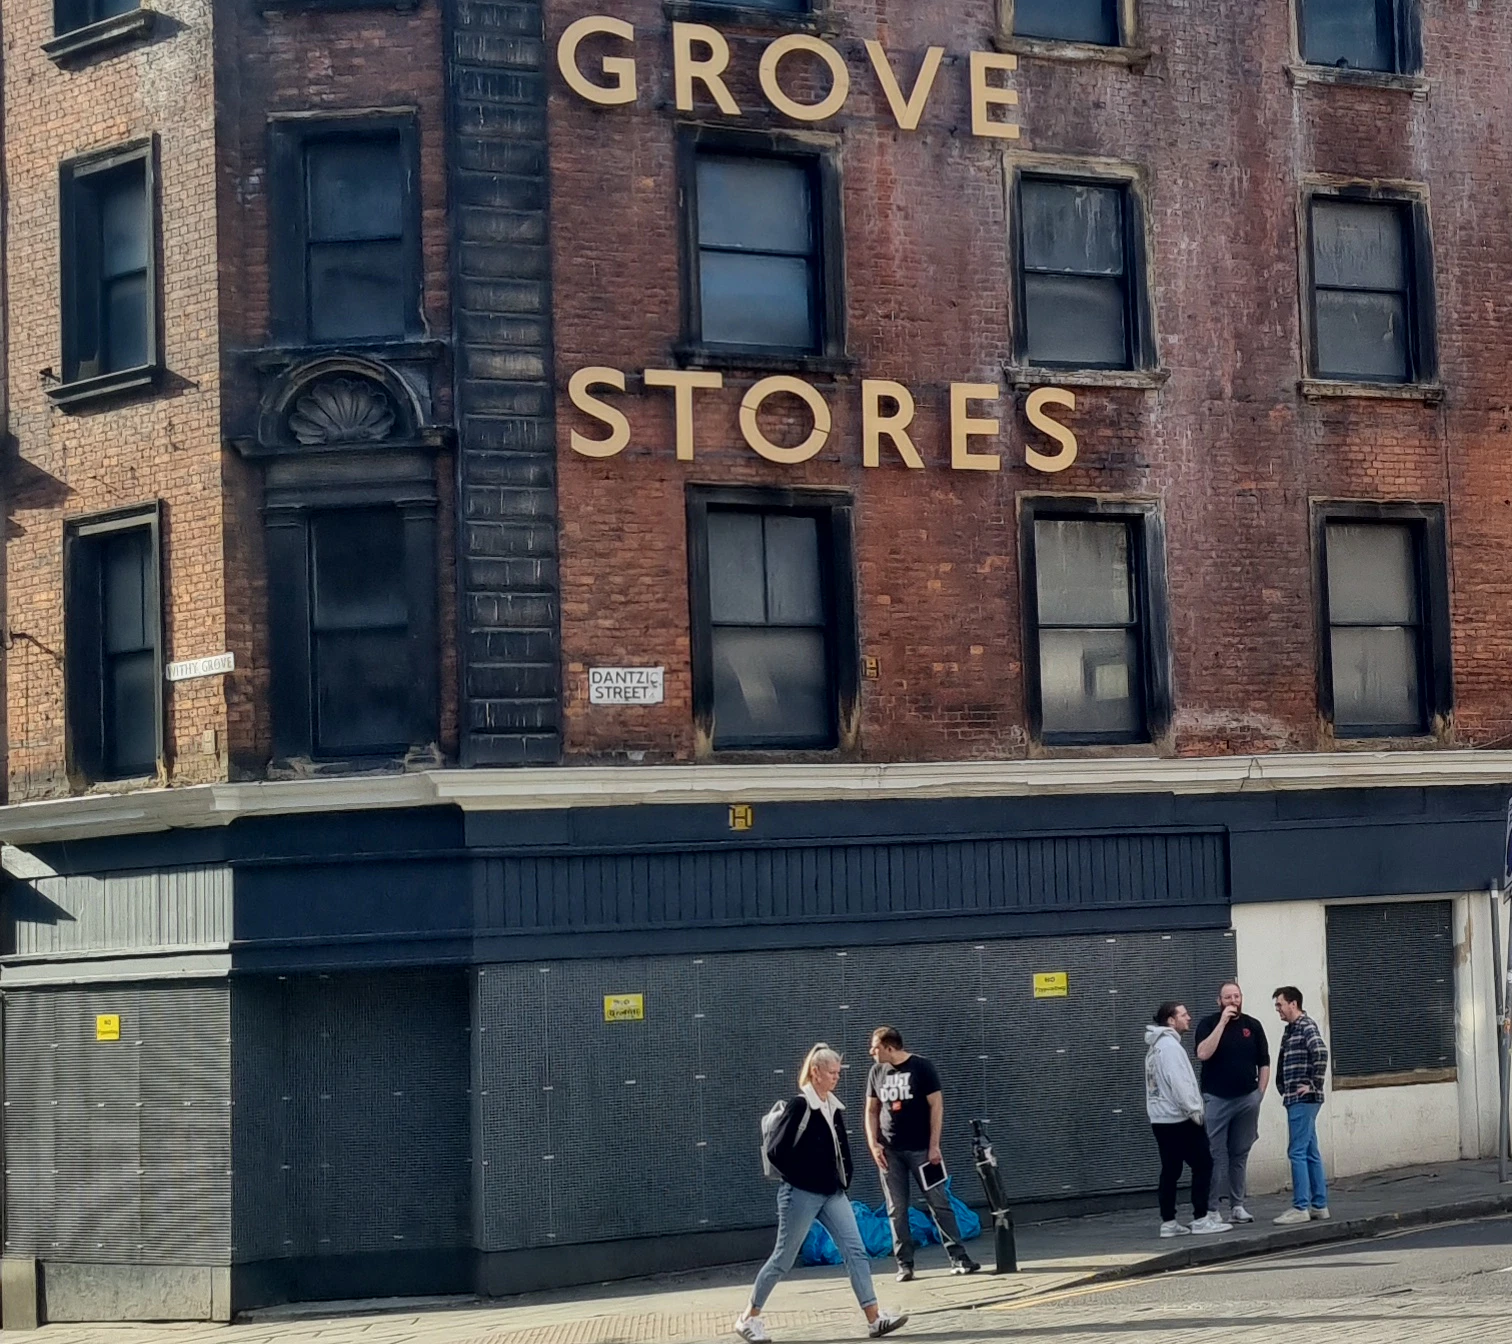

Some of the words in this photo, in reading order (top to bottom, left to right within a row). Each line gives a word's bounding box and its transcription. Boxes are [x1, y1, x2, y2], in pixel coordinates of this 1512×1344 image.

[557, 14, 1021, 140] GROVE
[569, 366, 1078, 473] STORES
[201, 656, 232, 673] GROVE
[591, 670, 660, 685] DANTZIC
[595, 686, 649, 699] STREET
[883, 1072, 912, 1088] JUST
[880, 1086, 899, 1102] DO
